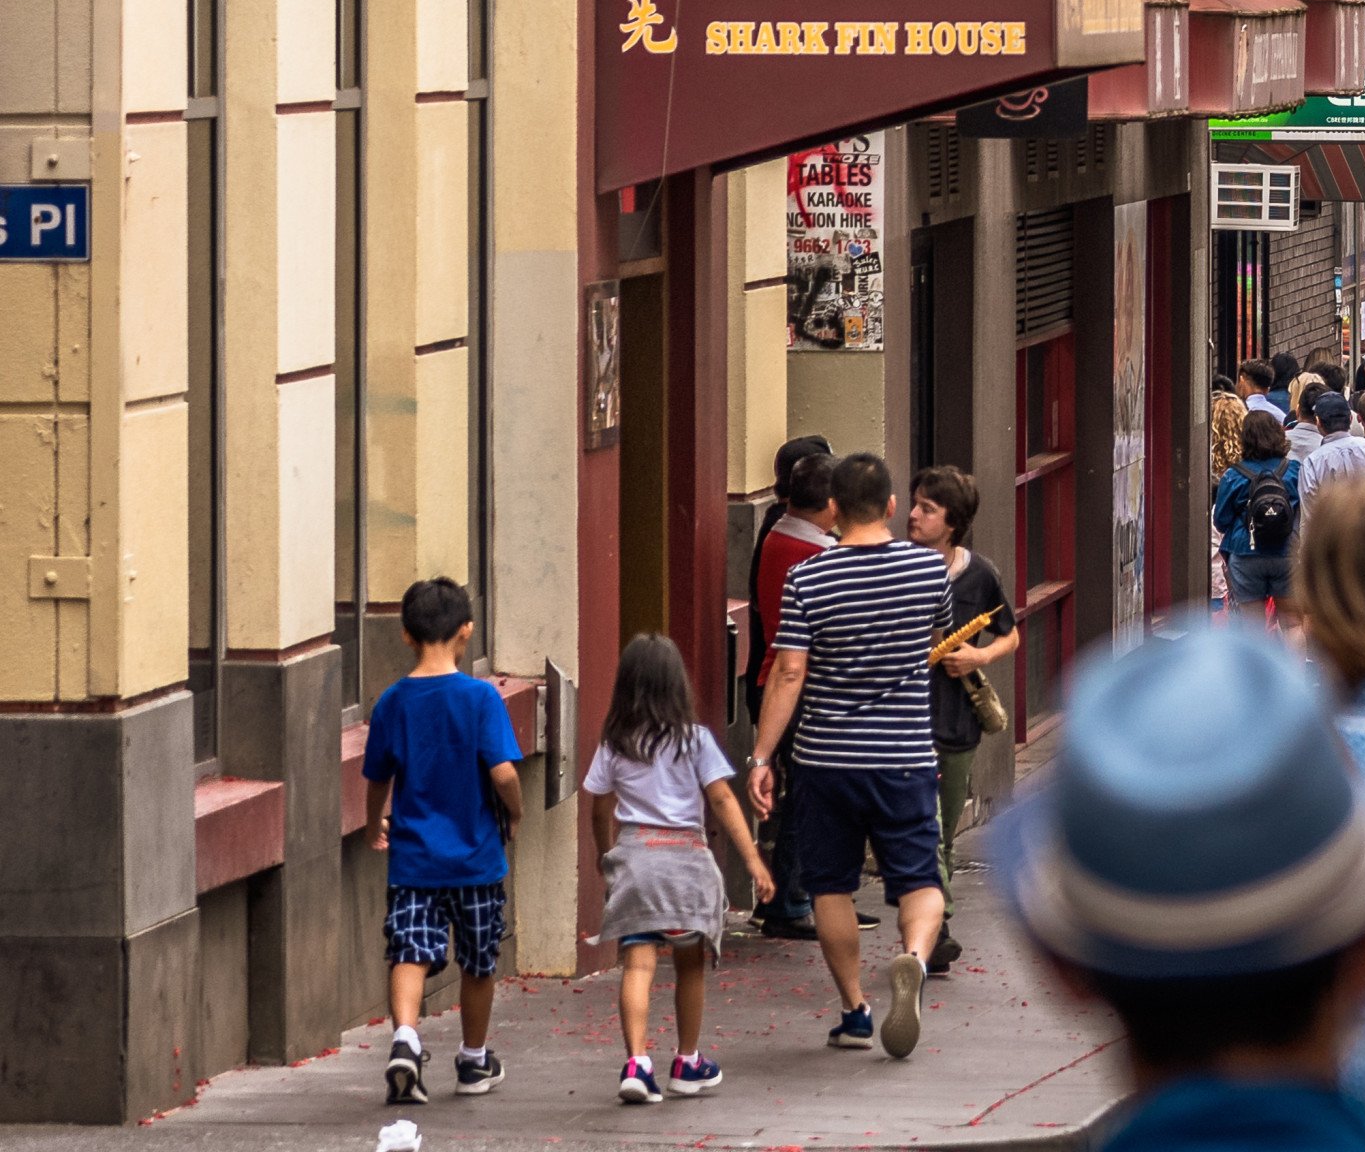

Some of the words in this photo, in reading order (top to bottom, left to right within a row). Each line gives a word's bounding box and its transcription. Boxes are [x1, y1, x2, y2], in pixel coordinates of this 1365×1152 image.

[705, 21, 830, 55] SHARK
[833, 21, 899, 55] FIN
[904, 21, 1027, 55] HOUSE
[797, 163, 872, 187] TABLES
[807, 192, 872, 208] KARAOKE
[30, 203, 76, 246] Pl
[840, 212, 872, 229] HIRE
[793, 239, 831, 254] 9662
